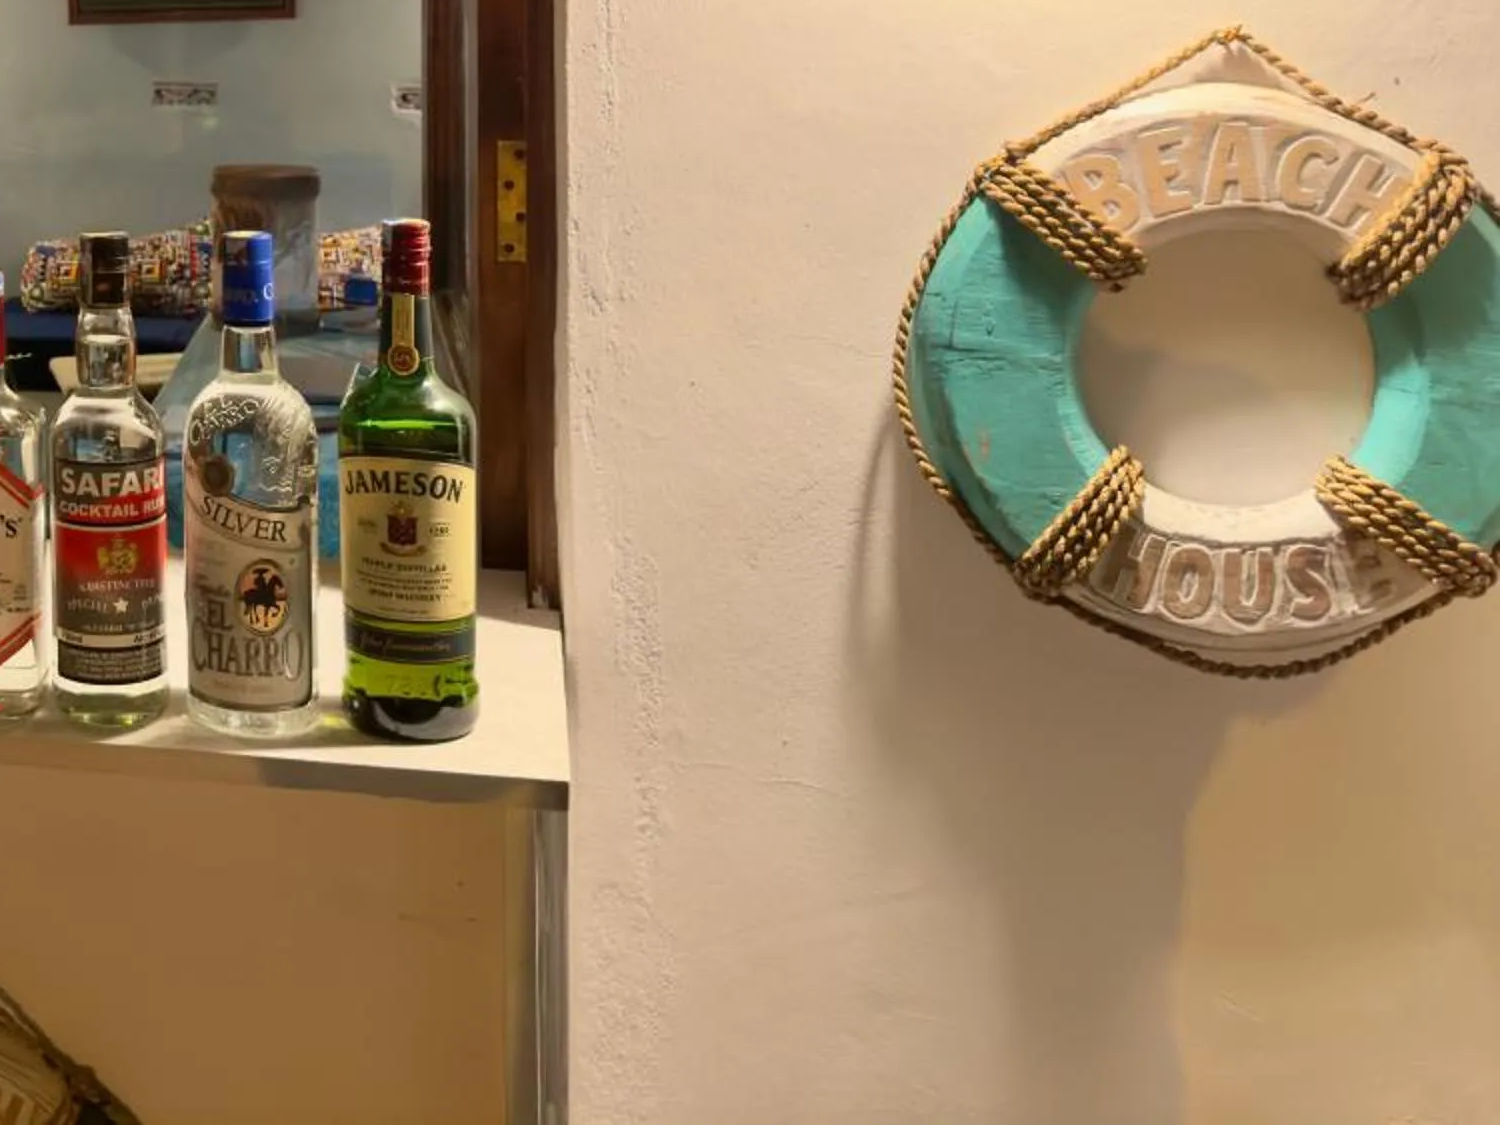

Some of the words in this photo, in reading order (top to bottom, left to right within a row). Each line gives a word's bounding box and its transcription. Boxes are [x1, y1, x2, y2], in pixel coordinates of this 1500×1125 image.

[1061, 121, 1405, 230] BEACH
[345, 470, 462, 503] JAMESON
[59, 500, 140, 518] COCKTAIL
[202, 496, 287, 542] SILVER
[207, 598, 233, 630] EL
[192, 617, 304, 681] CHARRO
